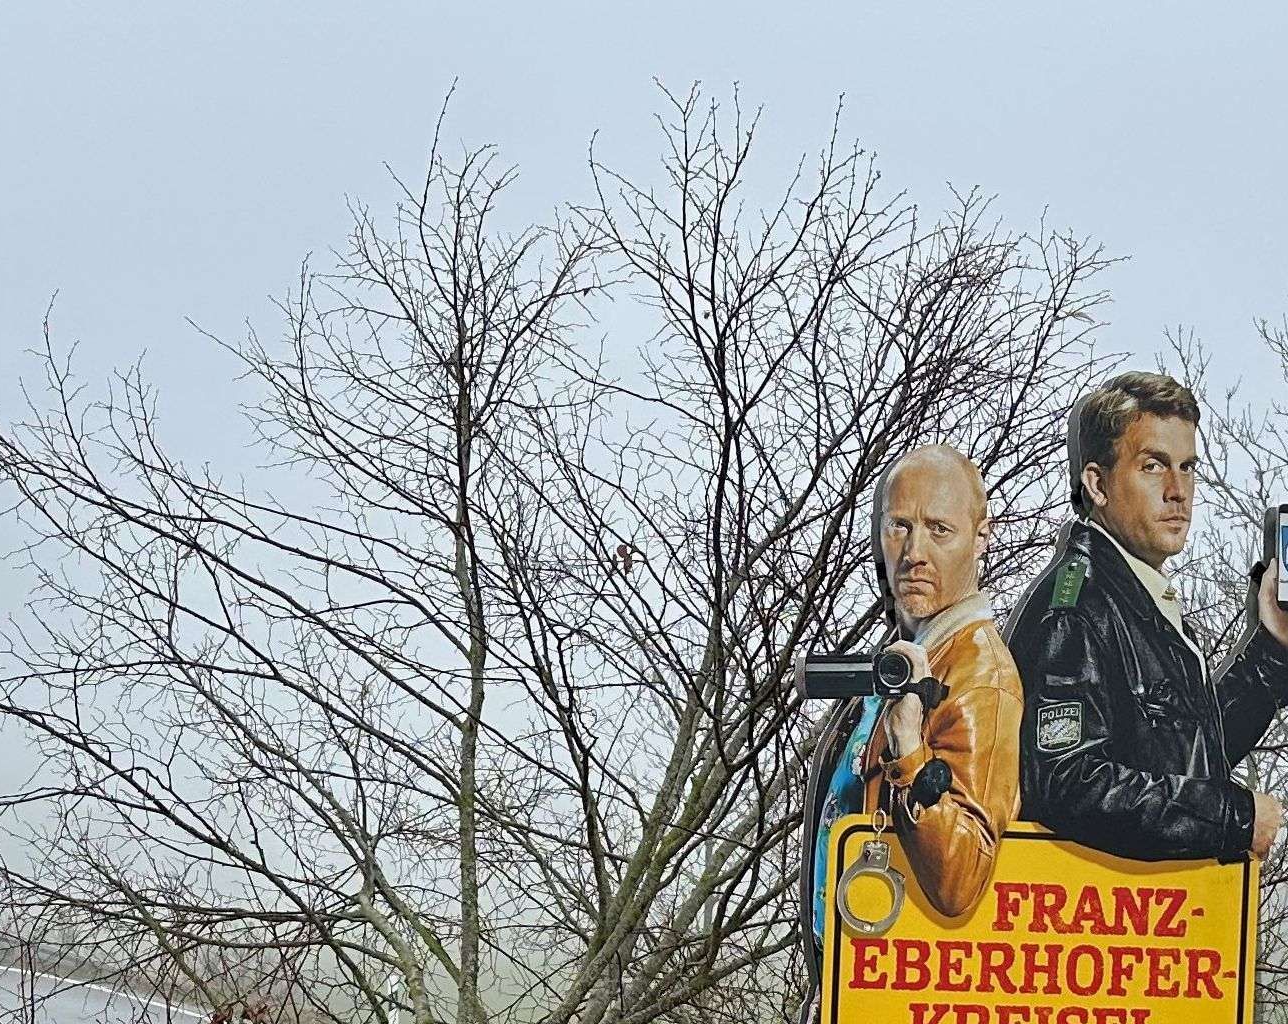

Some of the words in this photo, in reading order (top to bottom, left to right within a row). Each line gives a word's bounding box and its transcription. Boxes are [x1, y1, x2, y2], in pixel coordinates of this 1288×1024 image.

[1041, 707, 1079, 721] POLIZEI
[991, 881, 1205, 938] FRANZ-
[848, 938, 1237, 1000] EBERHOFER-
